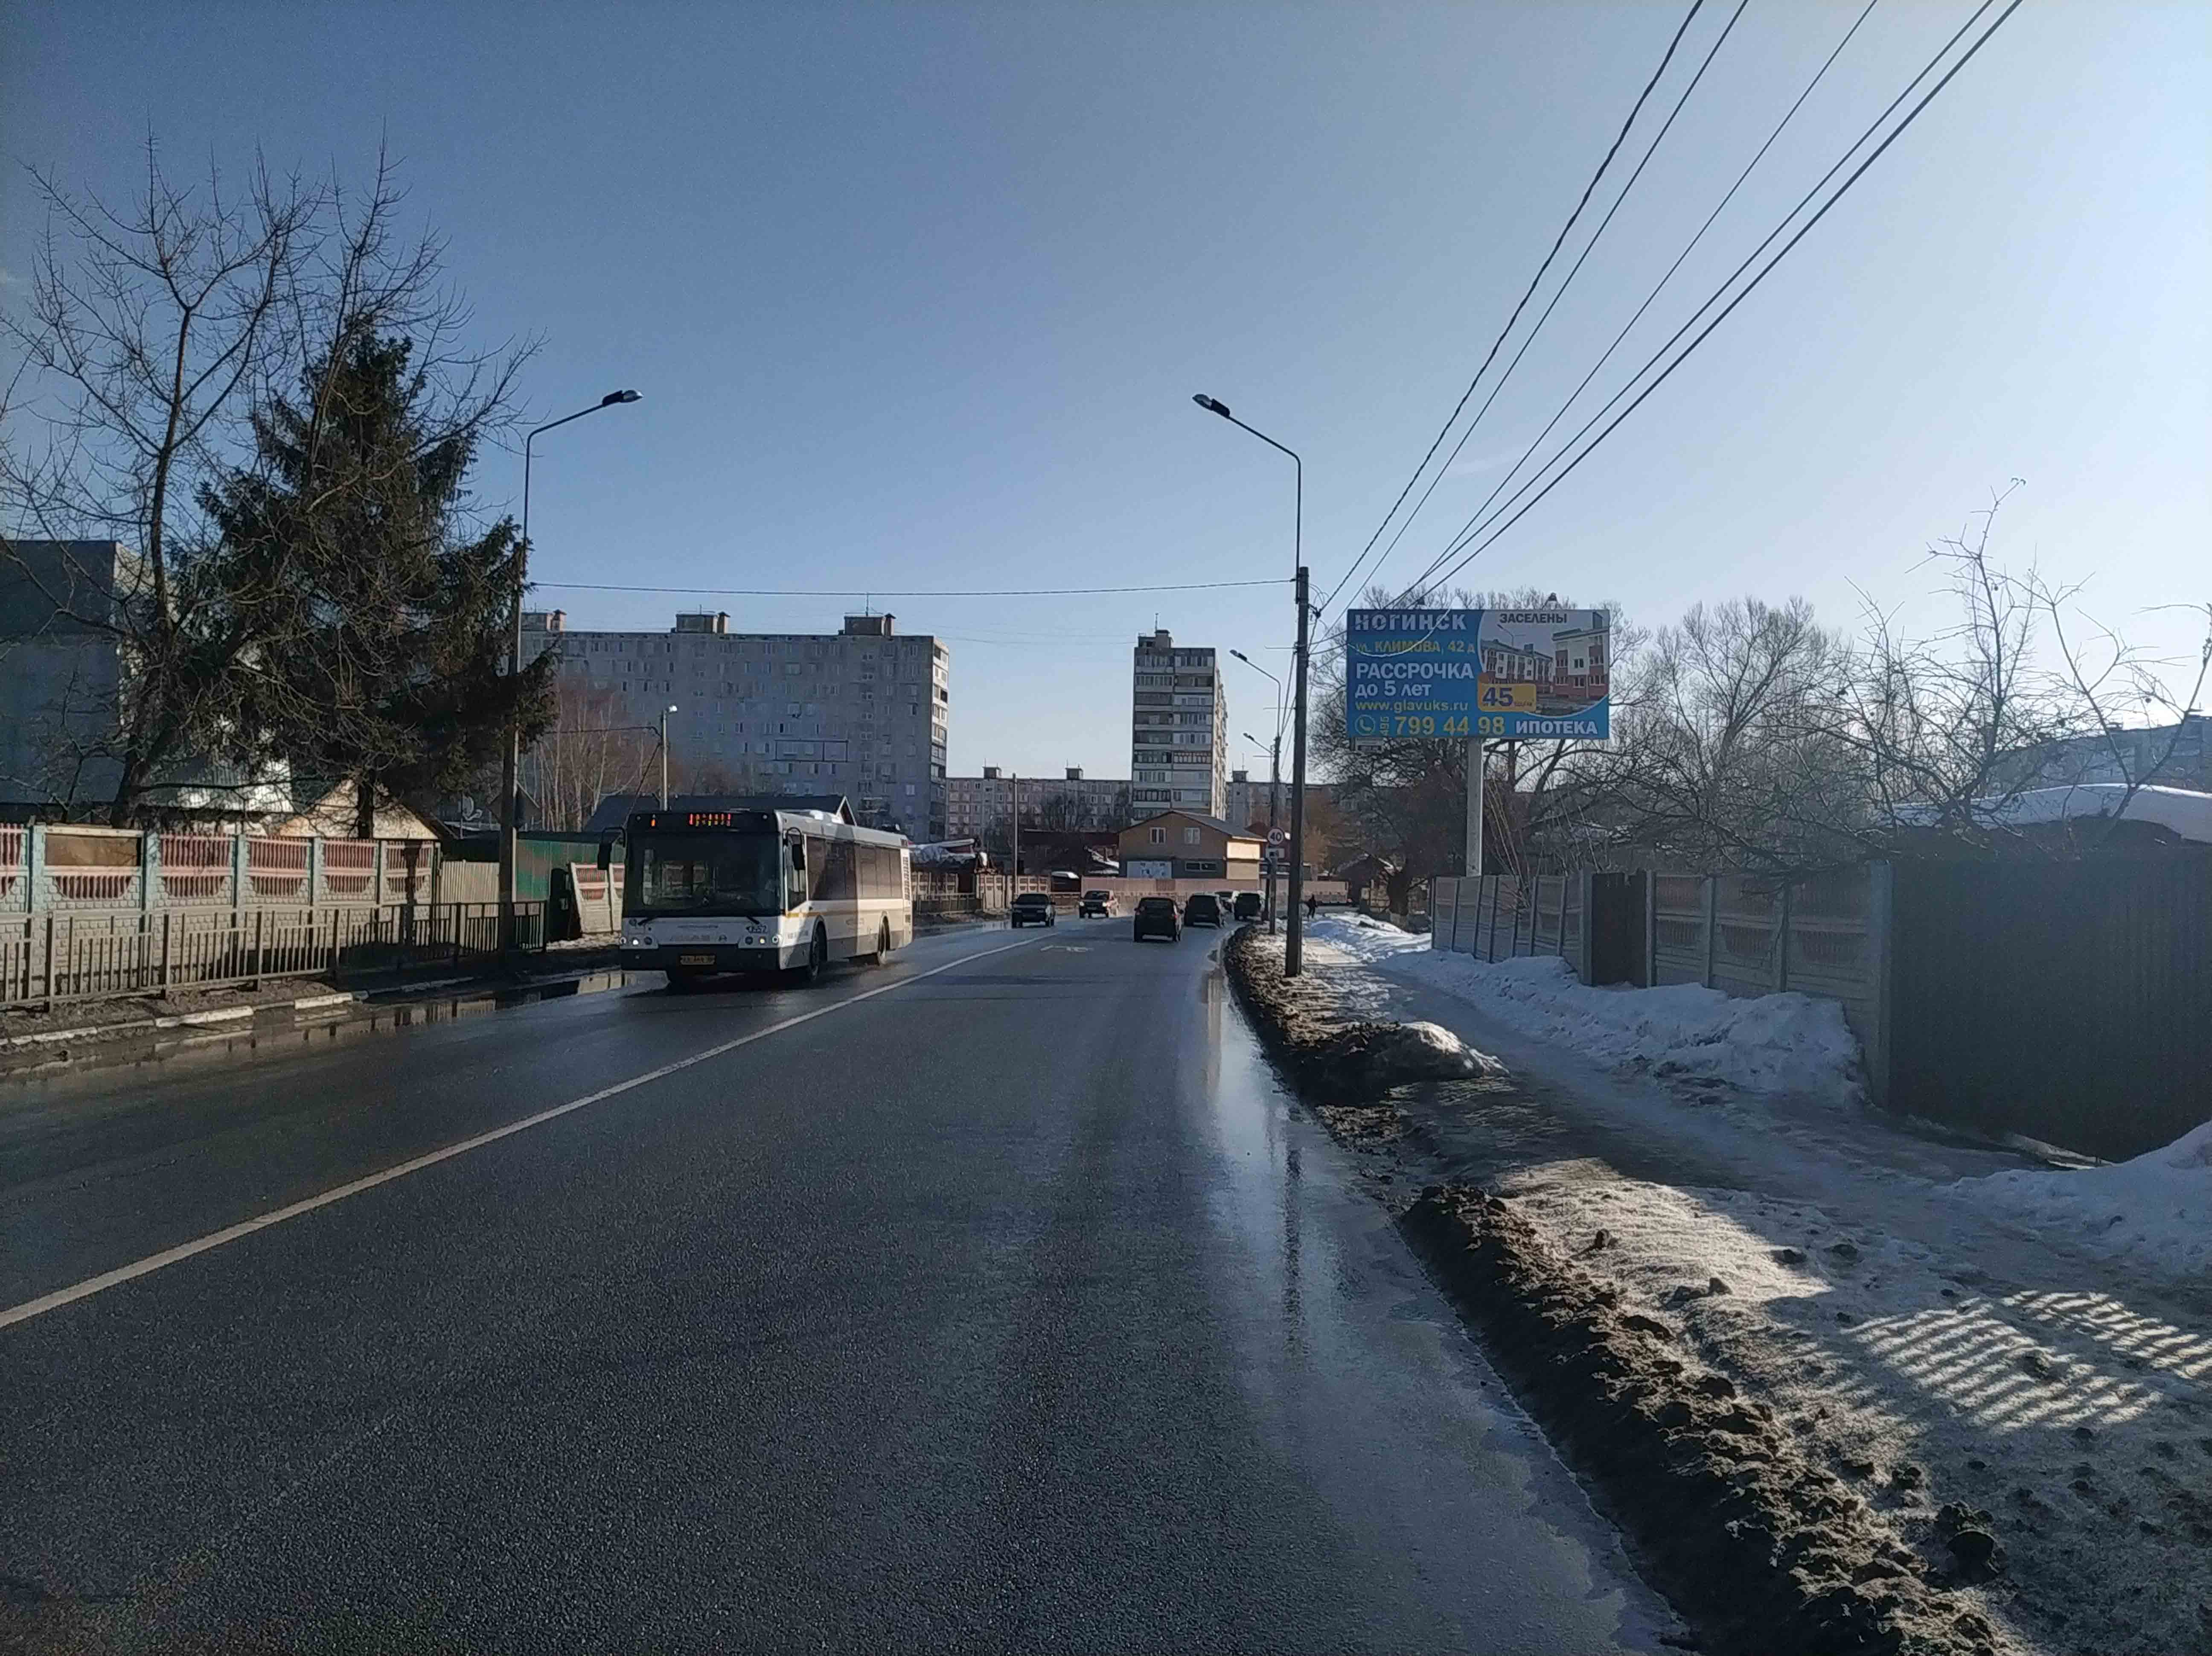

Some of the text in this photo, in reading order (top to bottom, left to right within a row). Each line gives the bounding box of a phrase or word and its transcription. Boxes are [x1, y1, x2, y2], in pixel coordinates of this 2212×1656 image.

[1355, 614, 1466, 630] НОГИНСК
[1499, 613, 1567, 623] ЗАСЕЛЕНЫ
[1447, 641, 1464, 653] 42
[1356, 663, 1474, 679] РАССРОЧКА
[1355, 680, 1432, 698] до 5 лет
[1482, 687, 1513, 706] 45
[1355, 700, 1469, 714] www.glavuks.ru
[1394, 716, 1435, 735] 799
[1443, 716, 1470, 736] 44
[1478, 717, 1505, 735] 98
[1516, 720, 1598, 735] ИПОТЕКА
[1270, 832, 1282, 841] 40
